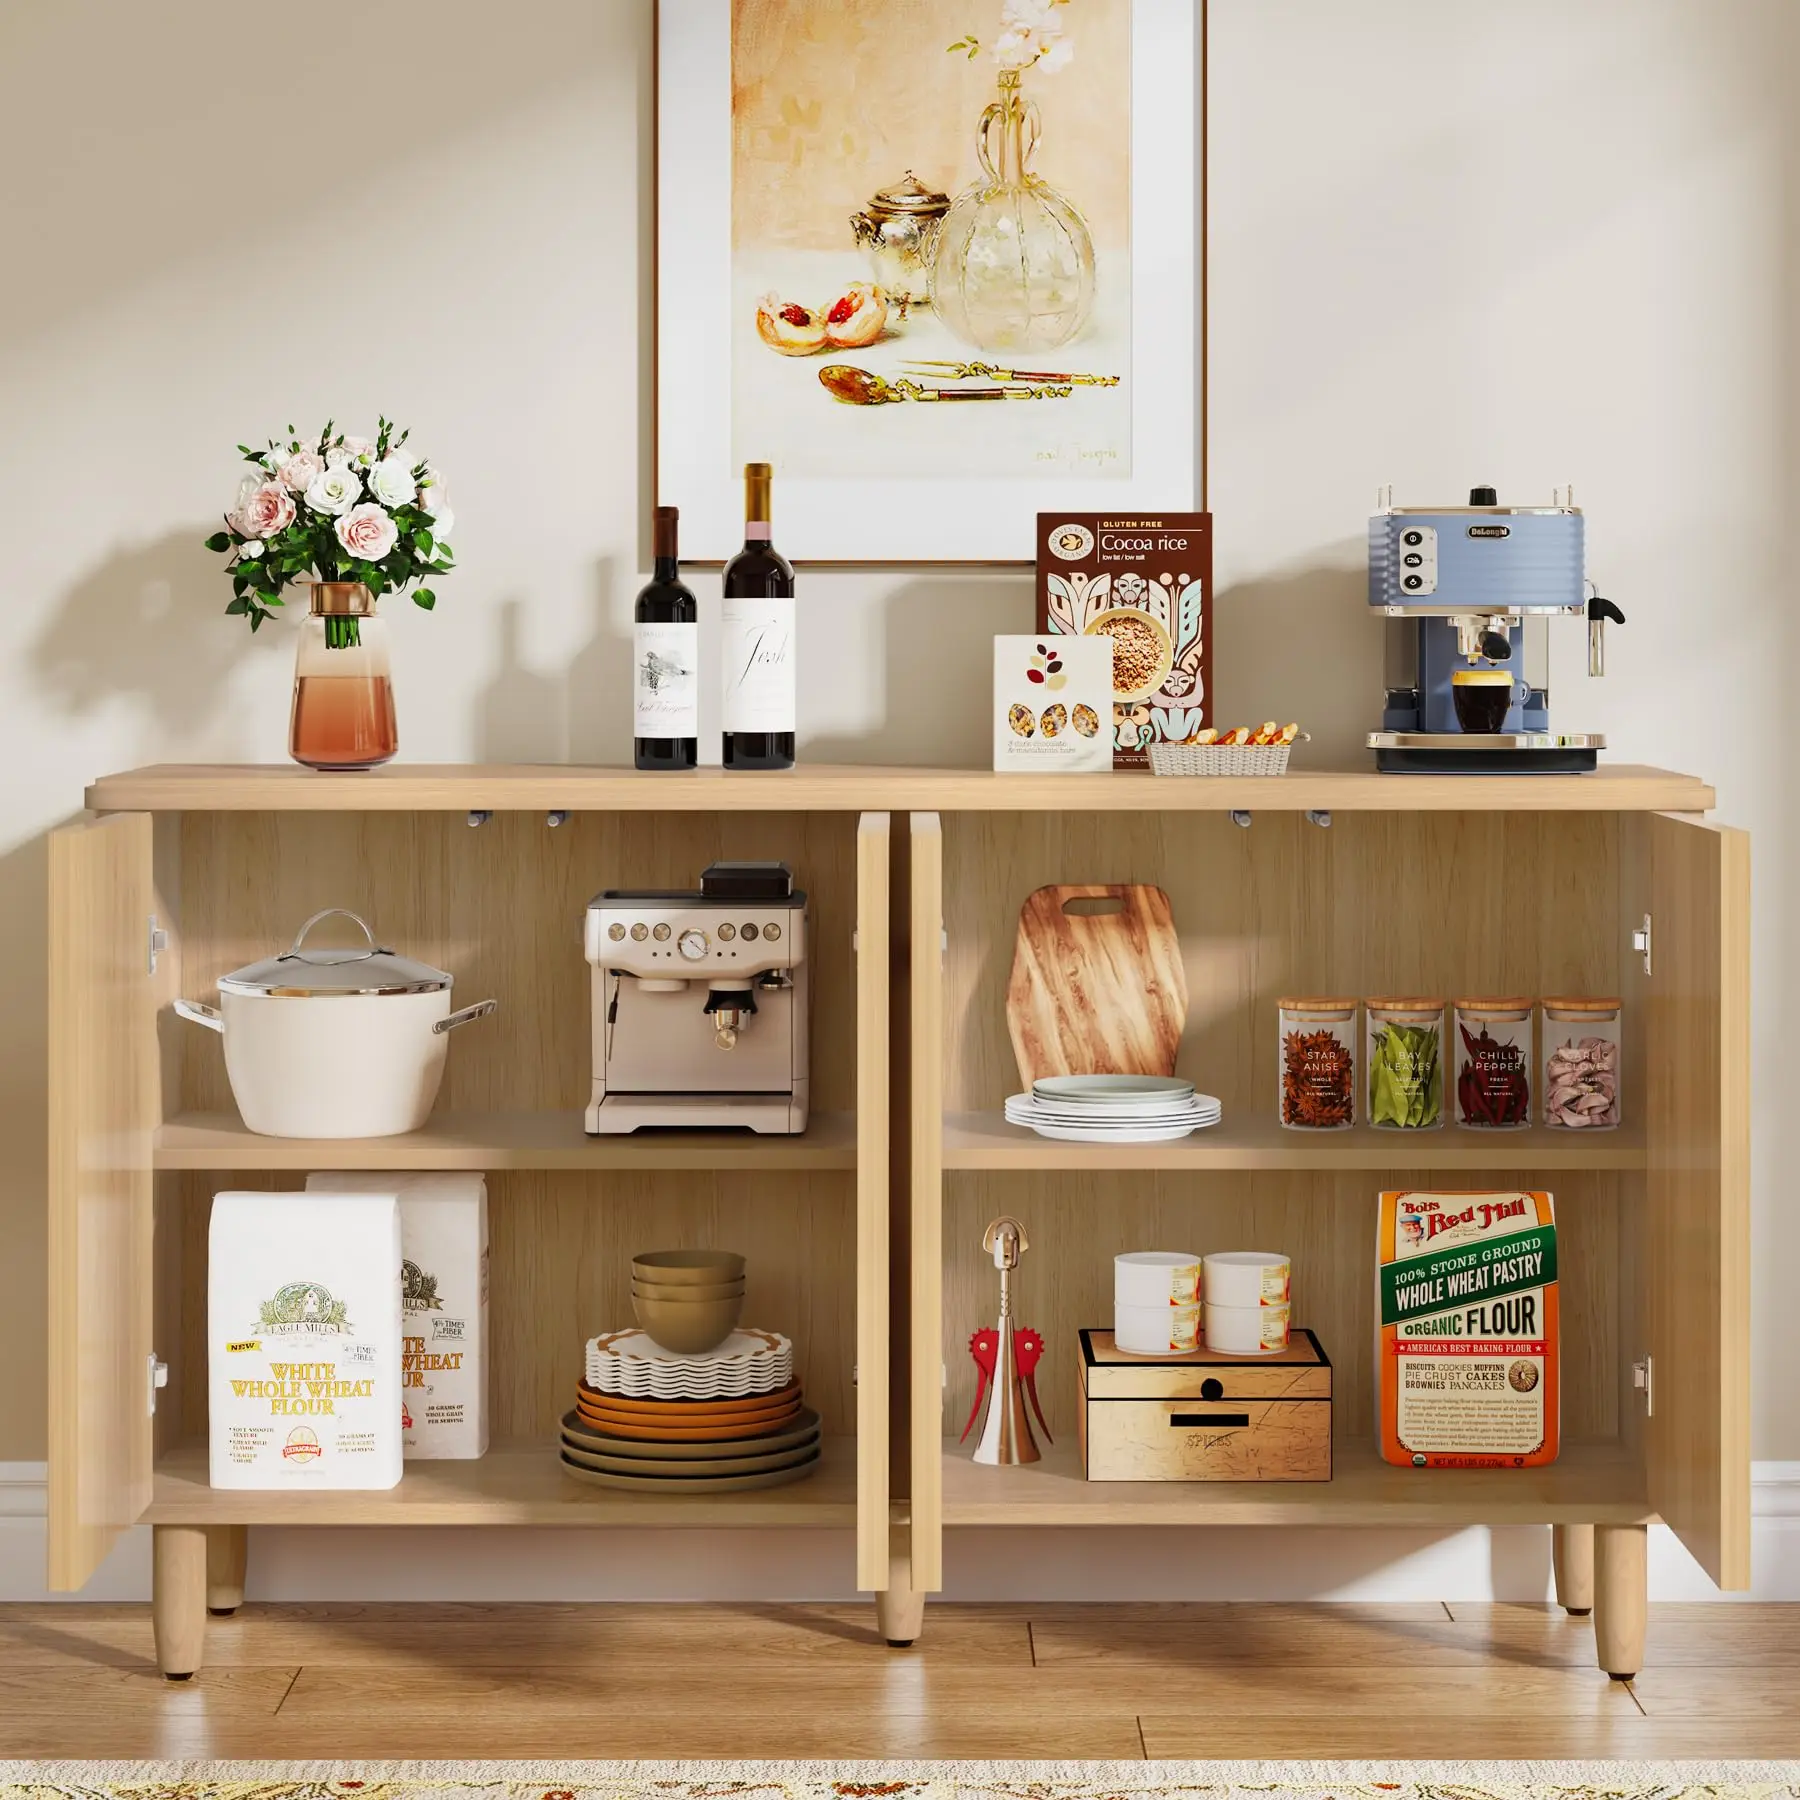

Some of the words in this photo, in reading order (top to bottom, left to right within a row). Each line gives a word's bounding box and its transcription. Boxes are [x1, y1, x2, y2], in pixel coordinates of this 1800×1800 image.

[1101, 534, 1153, 551] Cocoa
[1158, 534, 1188, 551] rice
[1307, 1051, 1336, 1060] STAR
[1398, 1051, 1421, 1060] BAY
[1479, 1052, 1518, 1060] CHILLI
[1567, 1051, 1609, 1060] GARLIC
[1303, 1063, 1339, 1071] ANISE
[1388, 1062, 1431, 1071] LEAVES
[1476, 1062, 1521, 1071] PEPPER
[1564, 1062, 1609, 1071] CLOVES
[1401, 1201, 1441, 1214] Bob's
[1427, 1206, 1476, 1241] Red
[1477, 1198, 1527, 1229] Mill
[1394, 1268, 1426, 1285] 100%
[1430, 1253, 1477, 1276] STONE
[1482, 1237, 1541, 1262] GROUND
[1395, 1278, 1444, 1312] WHOLE
[1447, 1265, 1489, 1297] WHEAT
[1493, 1251, 1543, 1286] PASTRY
[1404, 1313, 1463, 1336] ORGANIC
[1467, 1295, 1537, 1336] FLOUR
[230, 1342, 255, 1351] NEW
[1407, 1343, 1448, 1353] AMERICA'S
[1450, 1344, 1472, 1353] BEST
[1473, 1344, 1504, 1353] BAKING
[1506, 1344, 1532, 1353] FLOUR
[269, 1363, 336, 1380] WHITE
[1405, 1363, 1436, 1371] BISCUITS
[1405, 1372, 1421, 1380] PIE
[1425, 1372, 1461, 1380] CRUST
[1466, 1372, 1505, 1380] CAKES
[230, 1380, 301, 1398] WHOLE
[305, 1380, 375, 1398] WHEAT
[1405, 1381, 1446, 1389] BROWNIES
[1450, 1381, 1505, 1390] PANCAKES
[270, 1399, 335, 1416] FLOUR
